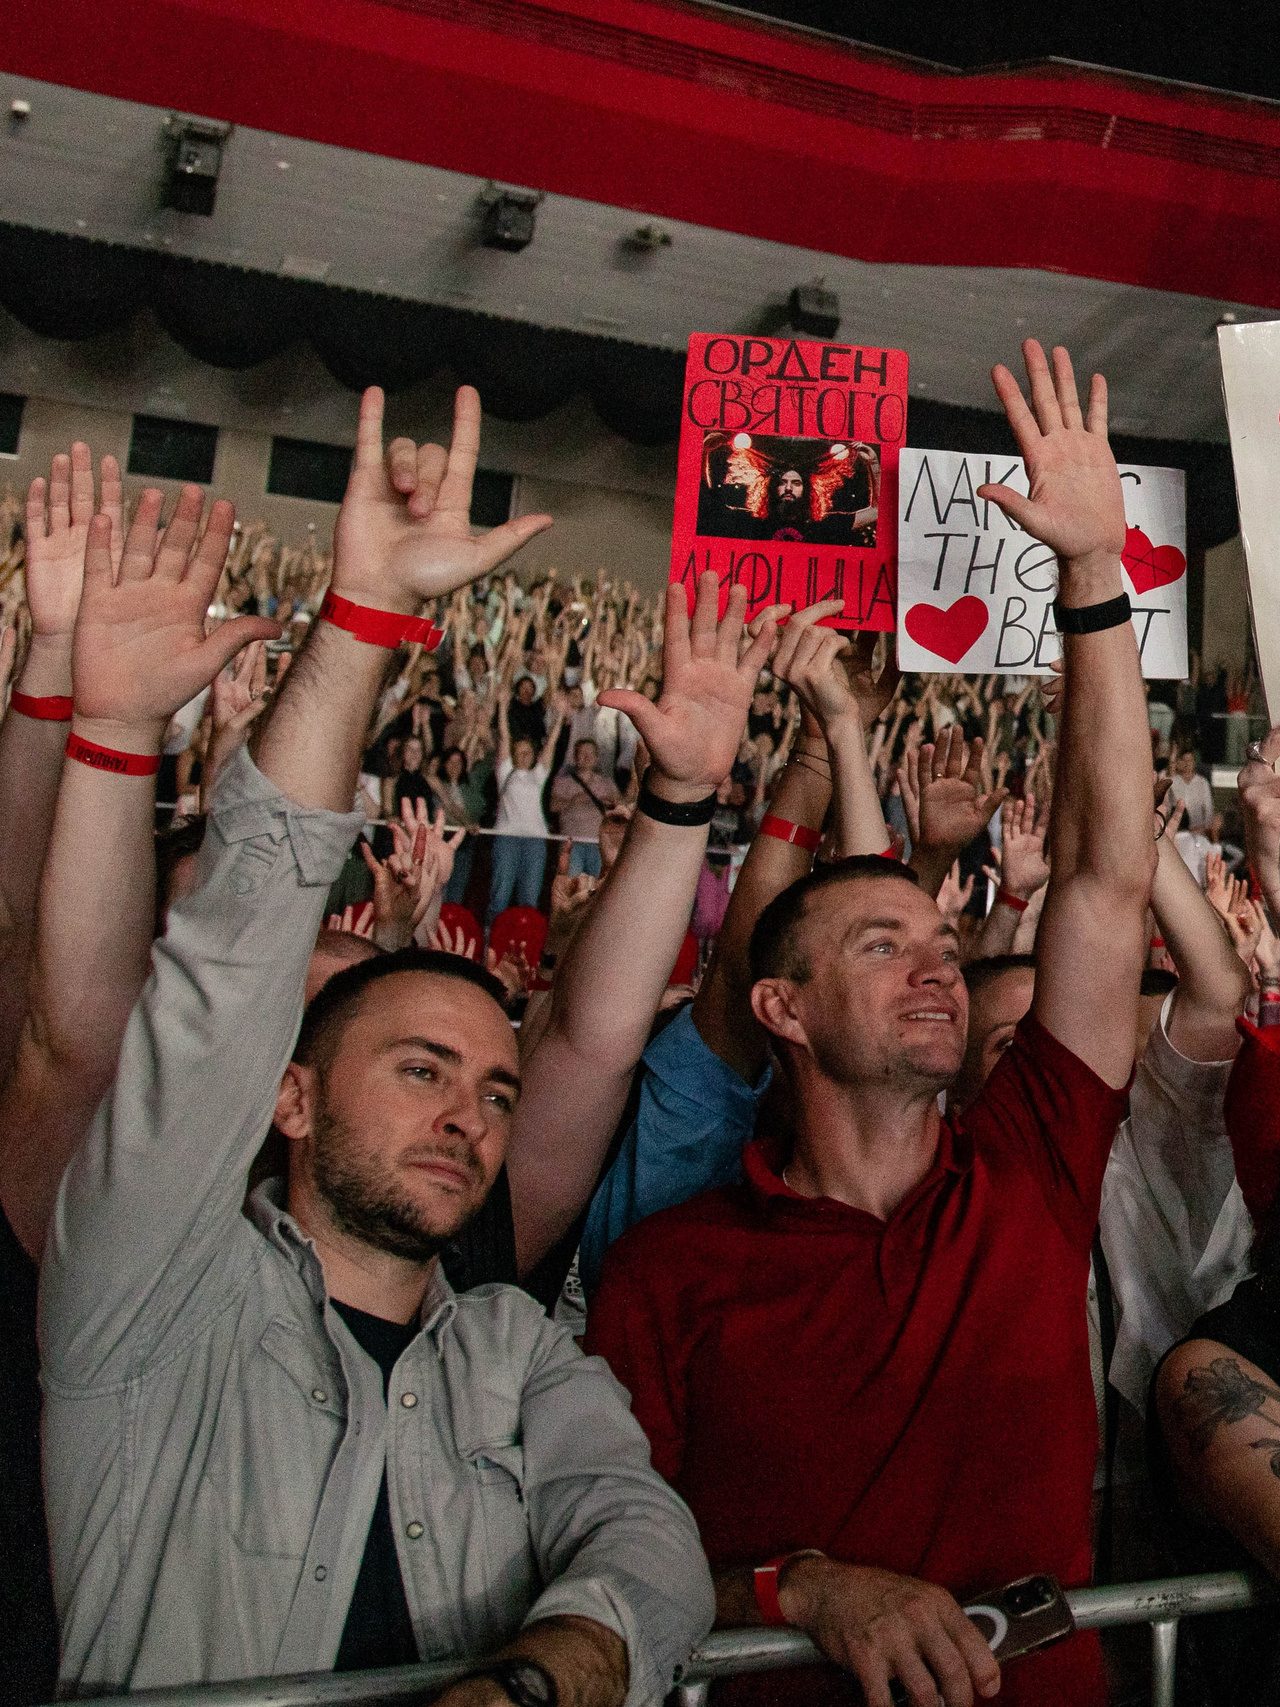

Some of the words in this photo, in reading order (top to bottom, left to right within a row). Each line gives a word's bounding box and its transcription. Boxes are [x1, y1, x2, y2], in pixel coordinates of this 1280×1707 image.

[704, 338, 888, 387] ОРДЕН
[687, 379, 905, 443] СВЯТОГО
[993, 596, 1171, 668] BET
